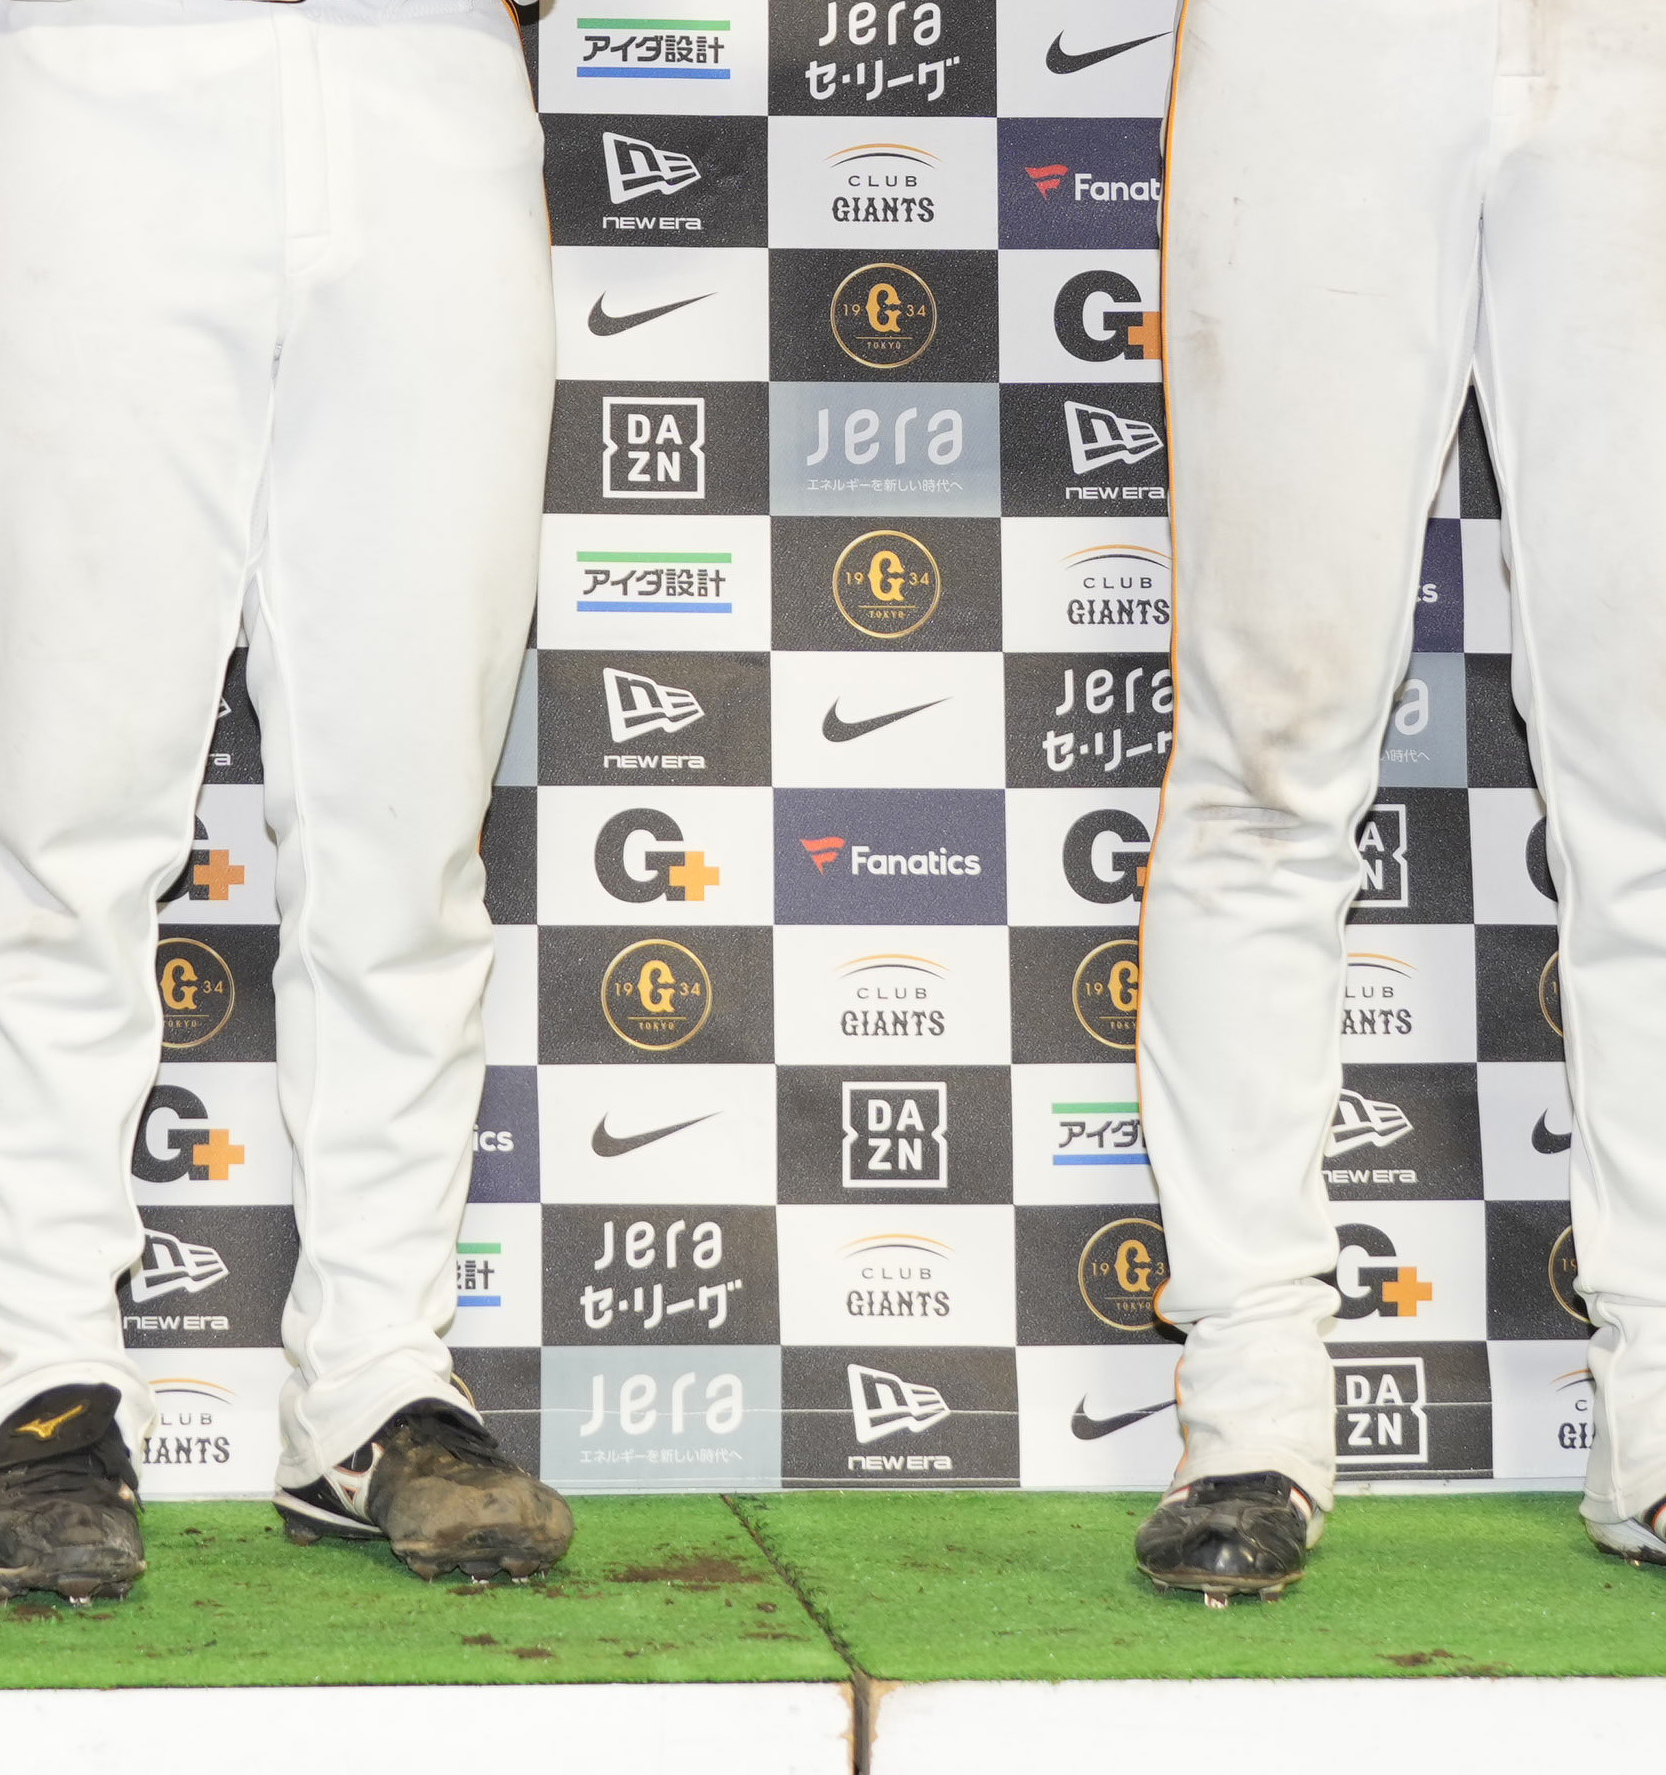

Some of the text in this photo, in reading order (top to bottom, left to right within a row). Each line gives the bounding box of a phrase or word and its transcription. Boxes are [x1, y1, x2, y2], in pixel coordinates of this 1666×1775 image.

[582, 34, 724, 64] アイダ設計
[847, 174, 917, 187] CLUB
[1074, 173, 1161, 201] Fanat
[831, 196, 934, 222] GIANTS
[582, 568, 726, 597] アイダ設計
[850, 845, 981, 875] Fanatics
[856, 987, 927, 1000] CLUB
[840, 1009, 945, 1036] GIANTS
[861, 1267, 932, 1280] CLUB
[845, 1289, 950, 1317] GIANTS
